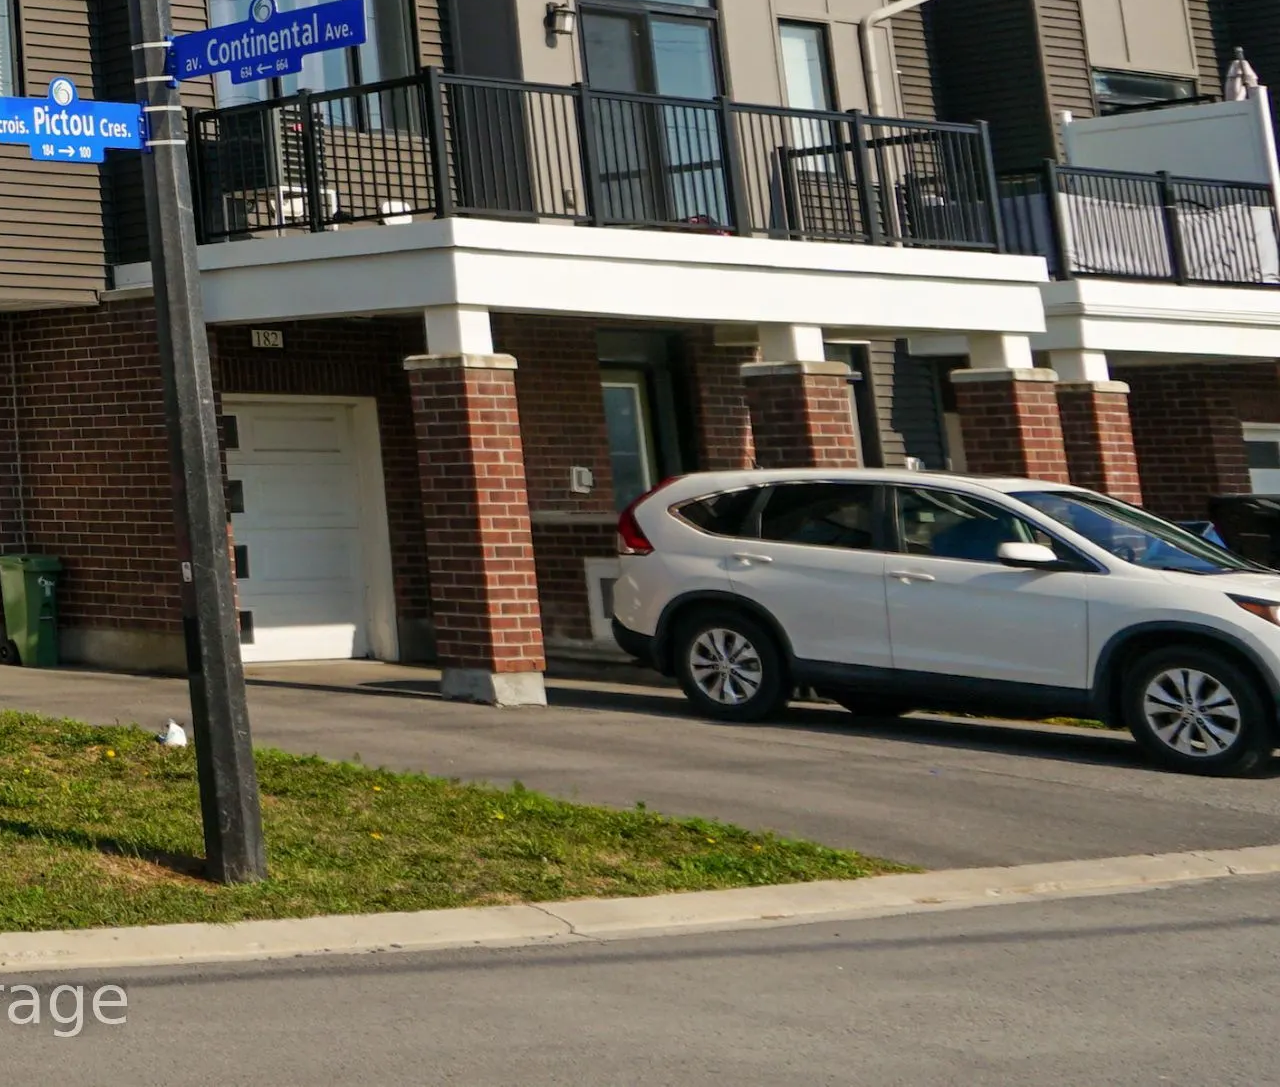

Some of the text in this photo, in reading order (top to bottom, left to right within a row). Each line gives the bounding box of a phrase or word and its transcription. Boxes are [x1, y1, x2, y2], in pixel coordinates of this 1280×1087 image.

[186, 13, 353, 72] av. Continental Ave.
[240, 65, 253, 79] 634
[33, 106, 95, 137] Pictou
[100, 118, 132, 138] Cres.
[42, 144, 92, 159] 184 100
[255, 330, 280, 347] 182
